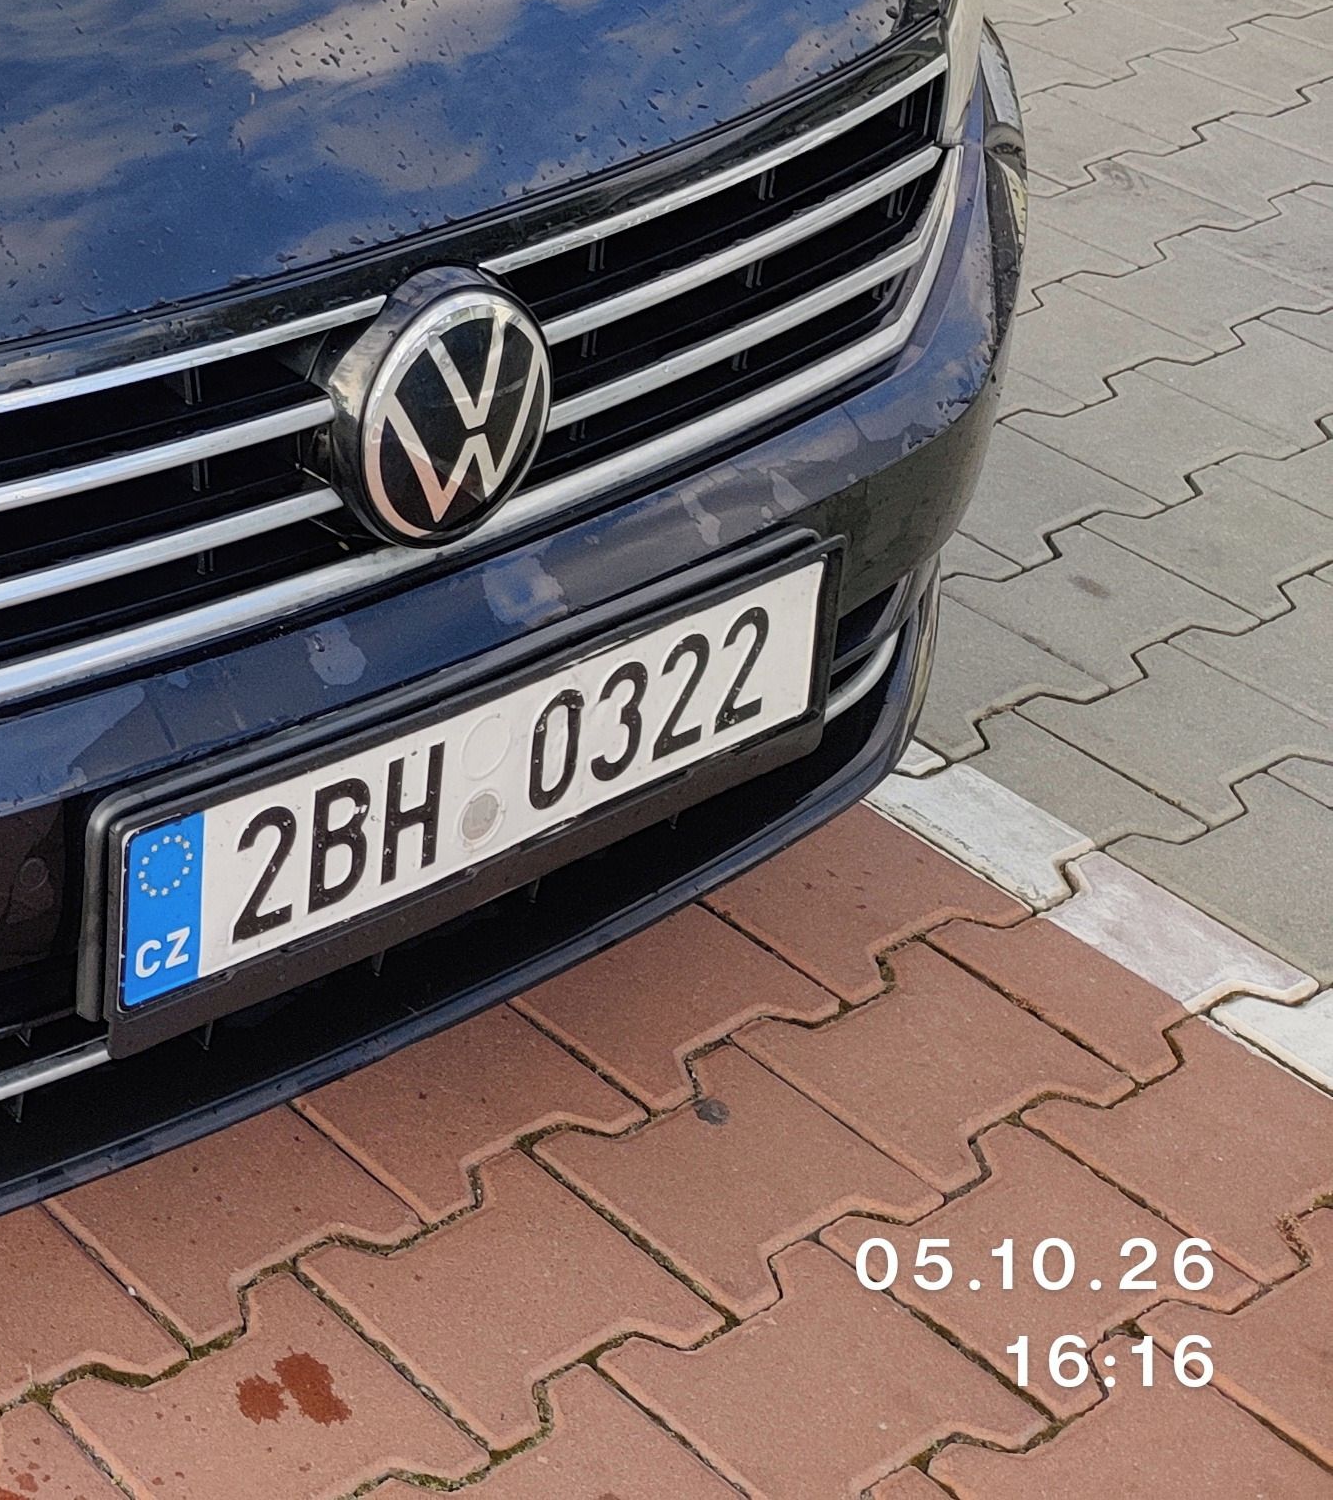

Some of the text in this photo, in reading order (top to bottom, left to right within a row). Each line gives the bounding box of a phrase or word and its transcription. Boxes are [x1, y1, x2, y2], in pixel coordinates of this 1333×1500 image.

[232, 605, 770, 945] 2BH 0322
[134, 926, 190, 980] CZ
